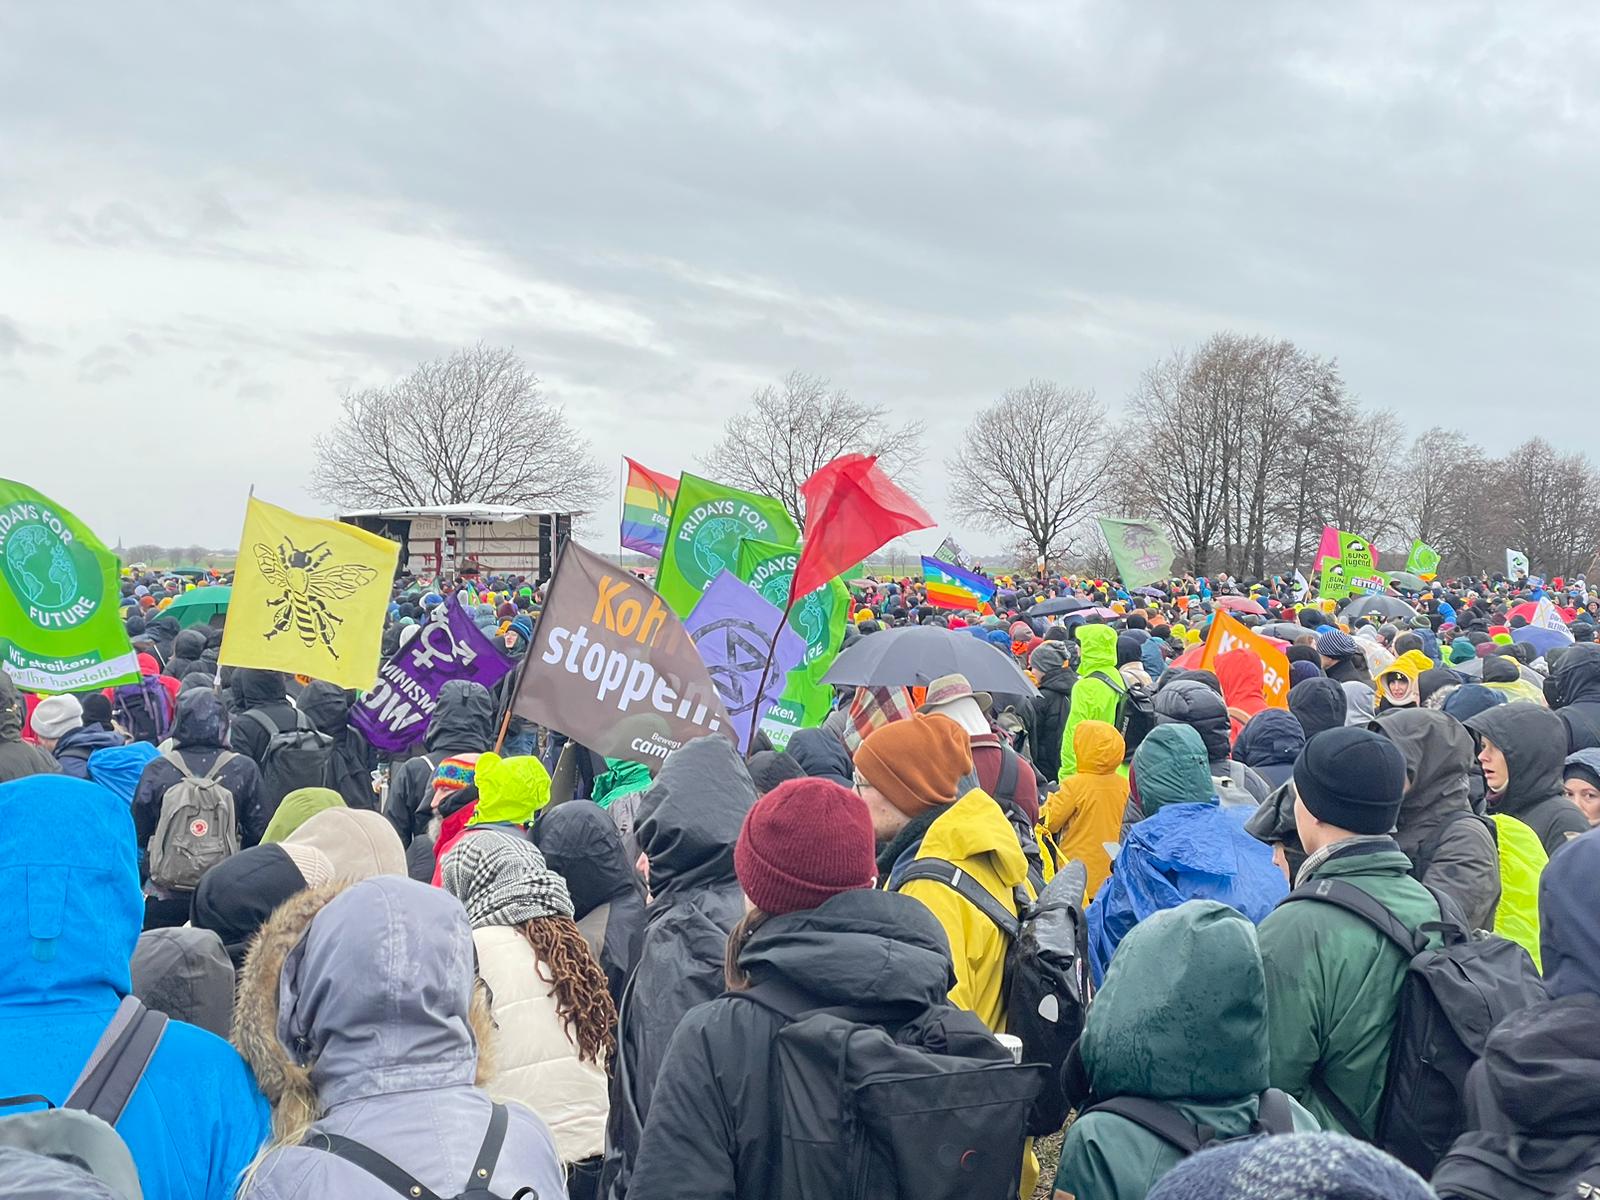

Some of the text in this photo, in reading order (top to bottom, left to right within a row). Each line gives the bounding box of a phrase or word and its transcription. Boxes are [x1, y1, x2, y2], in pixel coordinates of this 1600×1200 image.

[0, 504, 73, 553] IDAYS FOR
[679, 501, 768, 542] FRIDAYS FOR
[750, 556, 797, 592] RIDAYS
[30, 596, 95, 627] FUTURE
[9, 645, 96, 671] Wir streiken,
[360, 678, 423, 732] OW
